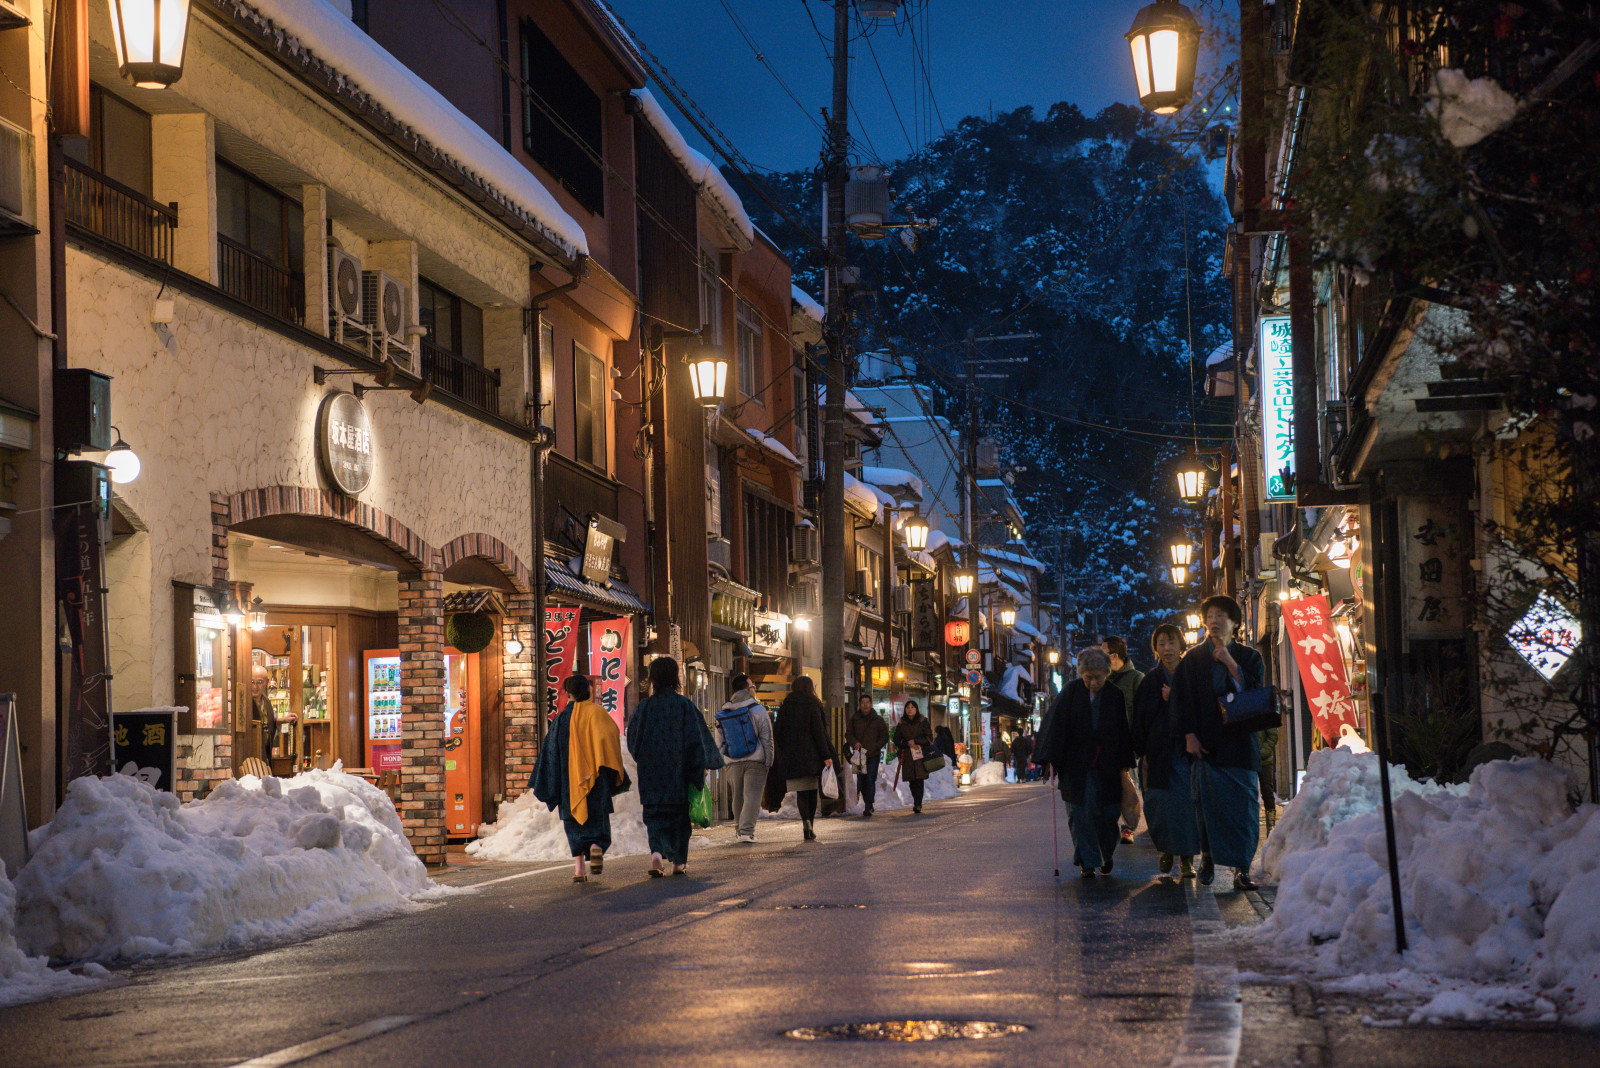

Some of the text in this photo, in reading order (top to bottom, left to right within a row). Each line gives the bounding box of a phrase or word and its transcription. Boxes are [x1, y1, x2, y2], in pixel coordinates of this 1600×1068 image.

[1270, 322, 1296, 472] 城崎工芸品センタ
[545, 625, 572, 722] どてま
